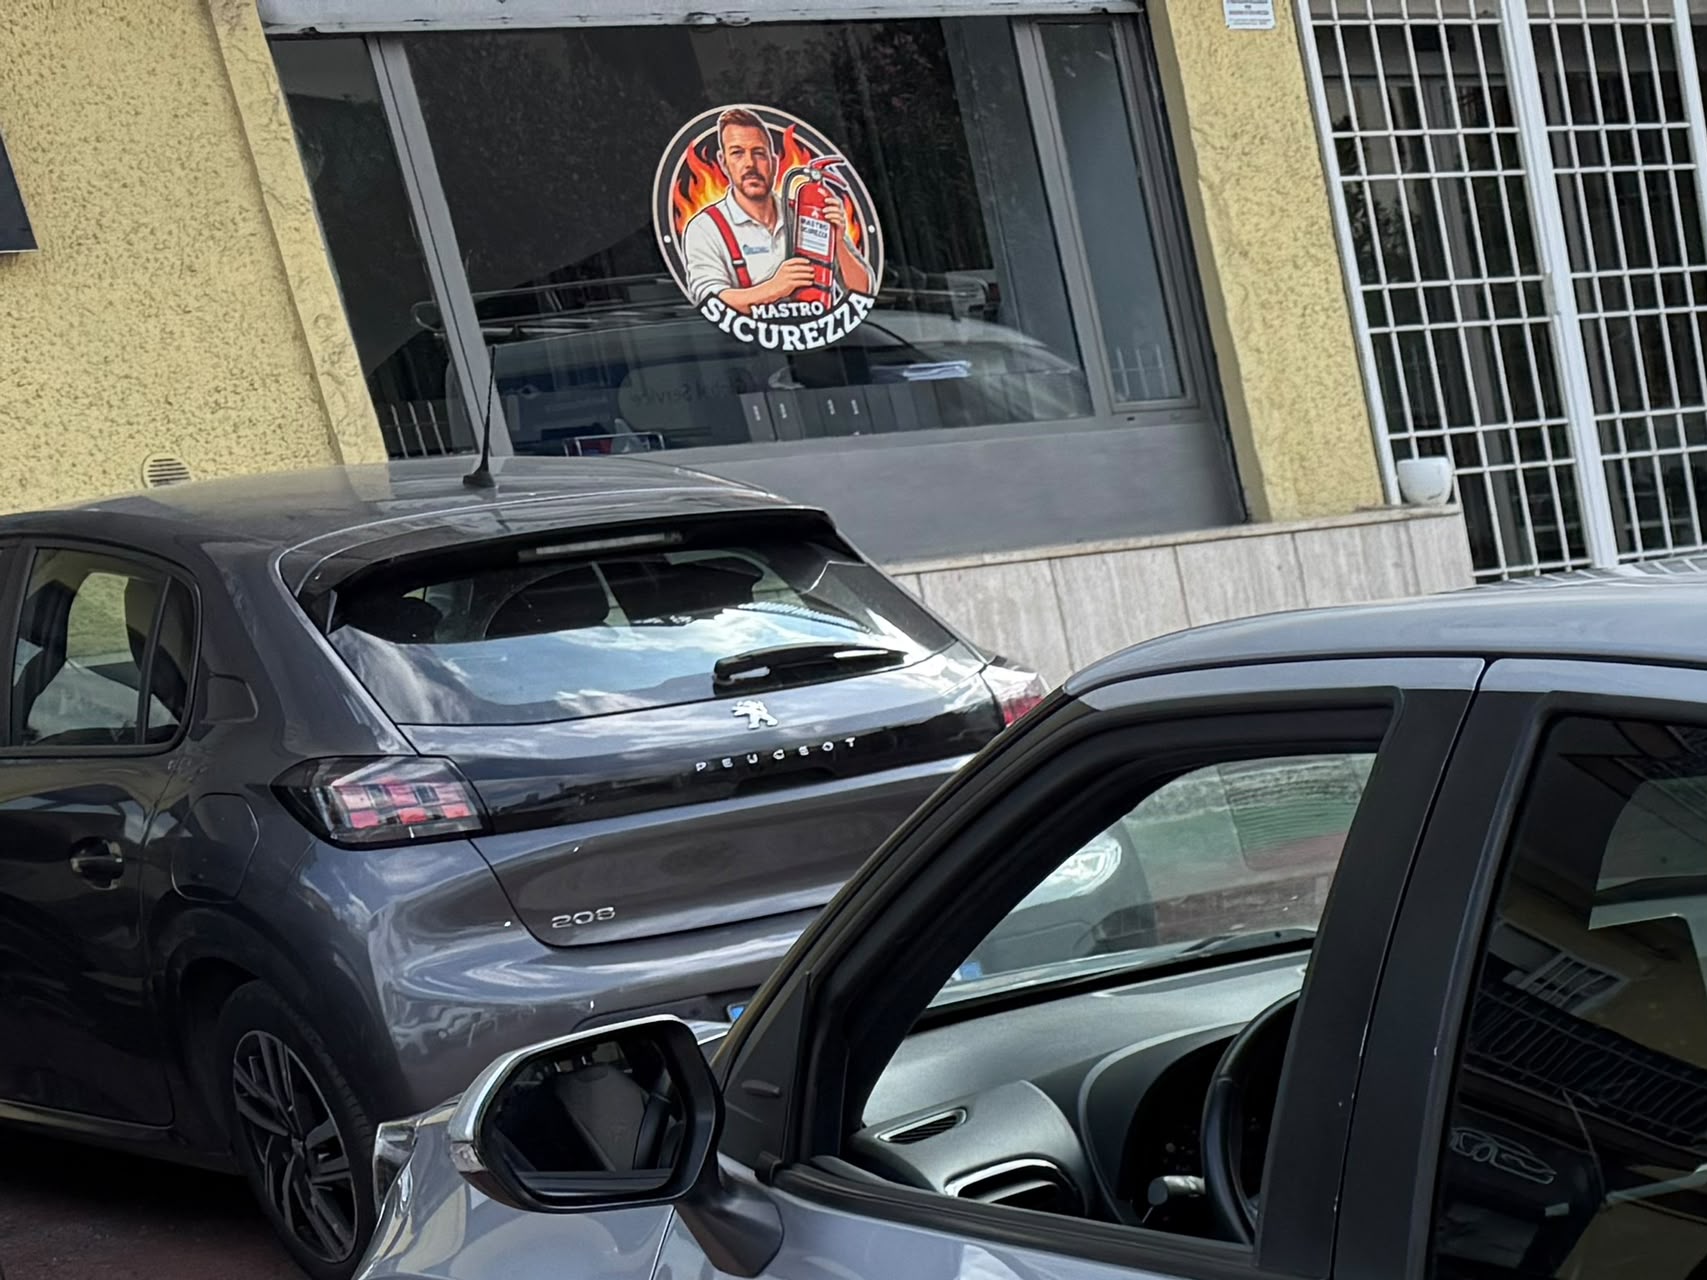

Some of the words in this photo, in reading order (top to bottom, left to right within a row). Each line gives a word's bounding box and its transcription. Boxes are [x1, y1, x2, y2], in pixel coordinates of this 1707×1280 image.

[701, 293, 875, 351] SICUREZZA
[751, 301, 824, 319] MASTRO
[695, 737, 856, 771] PEUGEOT
[551, 906, 616, 928] 208
